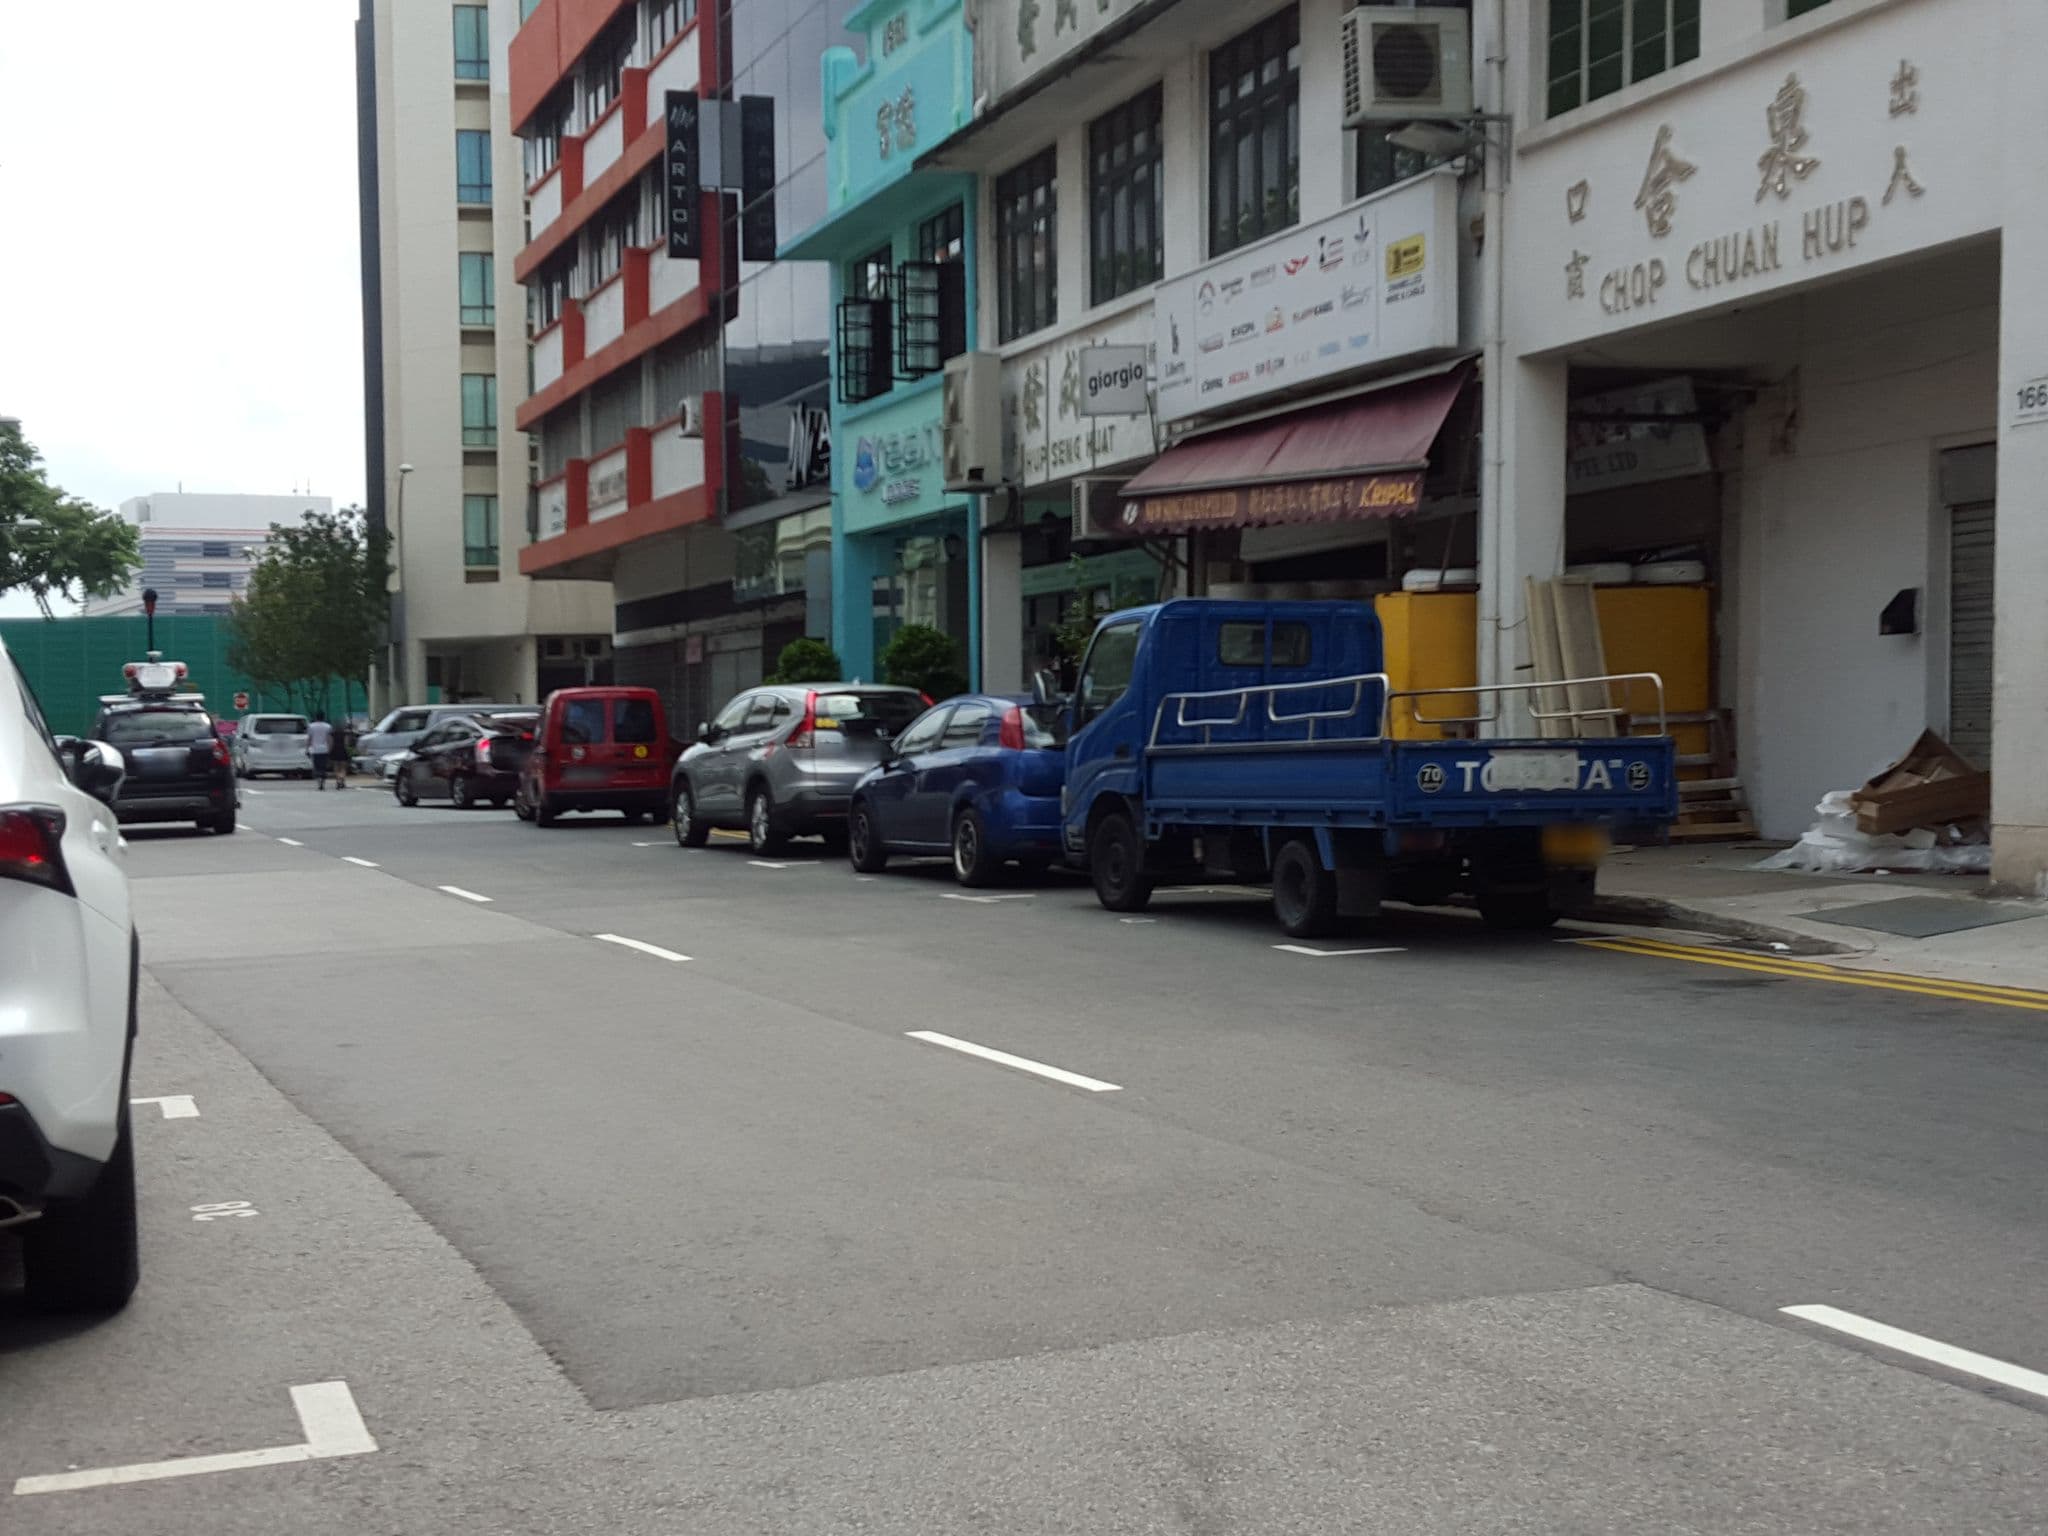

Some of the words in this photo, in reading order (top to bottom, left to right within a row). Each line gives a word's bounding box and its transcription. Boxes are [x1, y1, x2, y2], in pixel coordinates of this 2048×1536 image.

[1600, 257, 1665, 315] CHOP
[1685, 218, 1782, 290] CHUAN
[1803, 195, 1868, 261] HUP
[1088, 361, 1143, 396] giorgio
[1051, 432, 1082, 468] SENG
